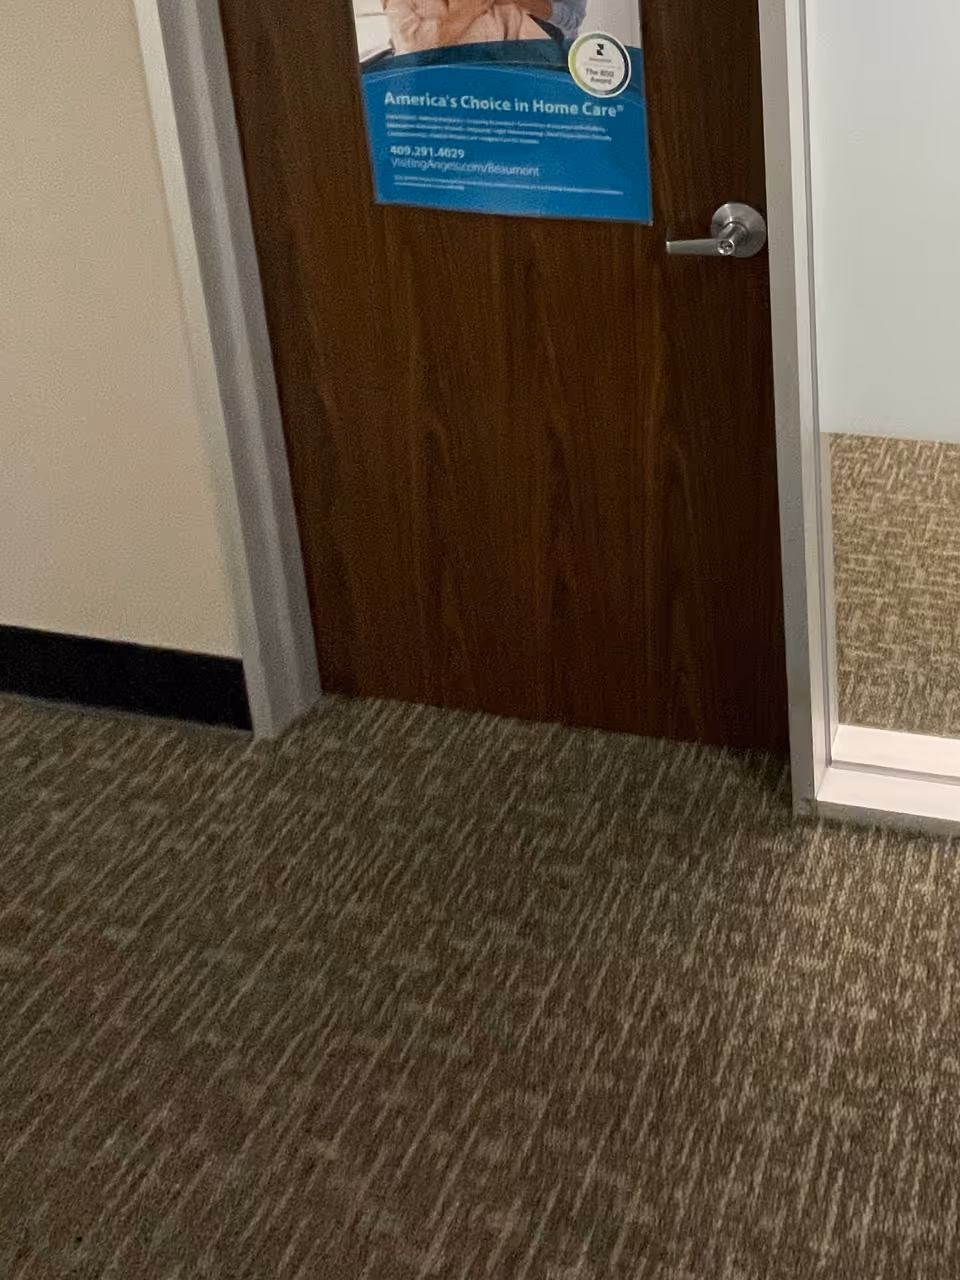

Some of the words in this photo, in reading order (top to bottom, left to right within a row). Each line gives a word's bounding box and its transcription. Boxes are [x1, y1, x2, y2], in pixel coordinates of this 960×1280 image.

[385, 91, 458, 108] America's
[460, 95, 511, 111] Choice
[514, 98, 529, 113] in
[533, 99, 579, 115] Home
